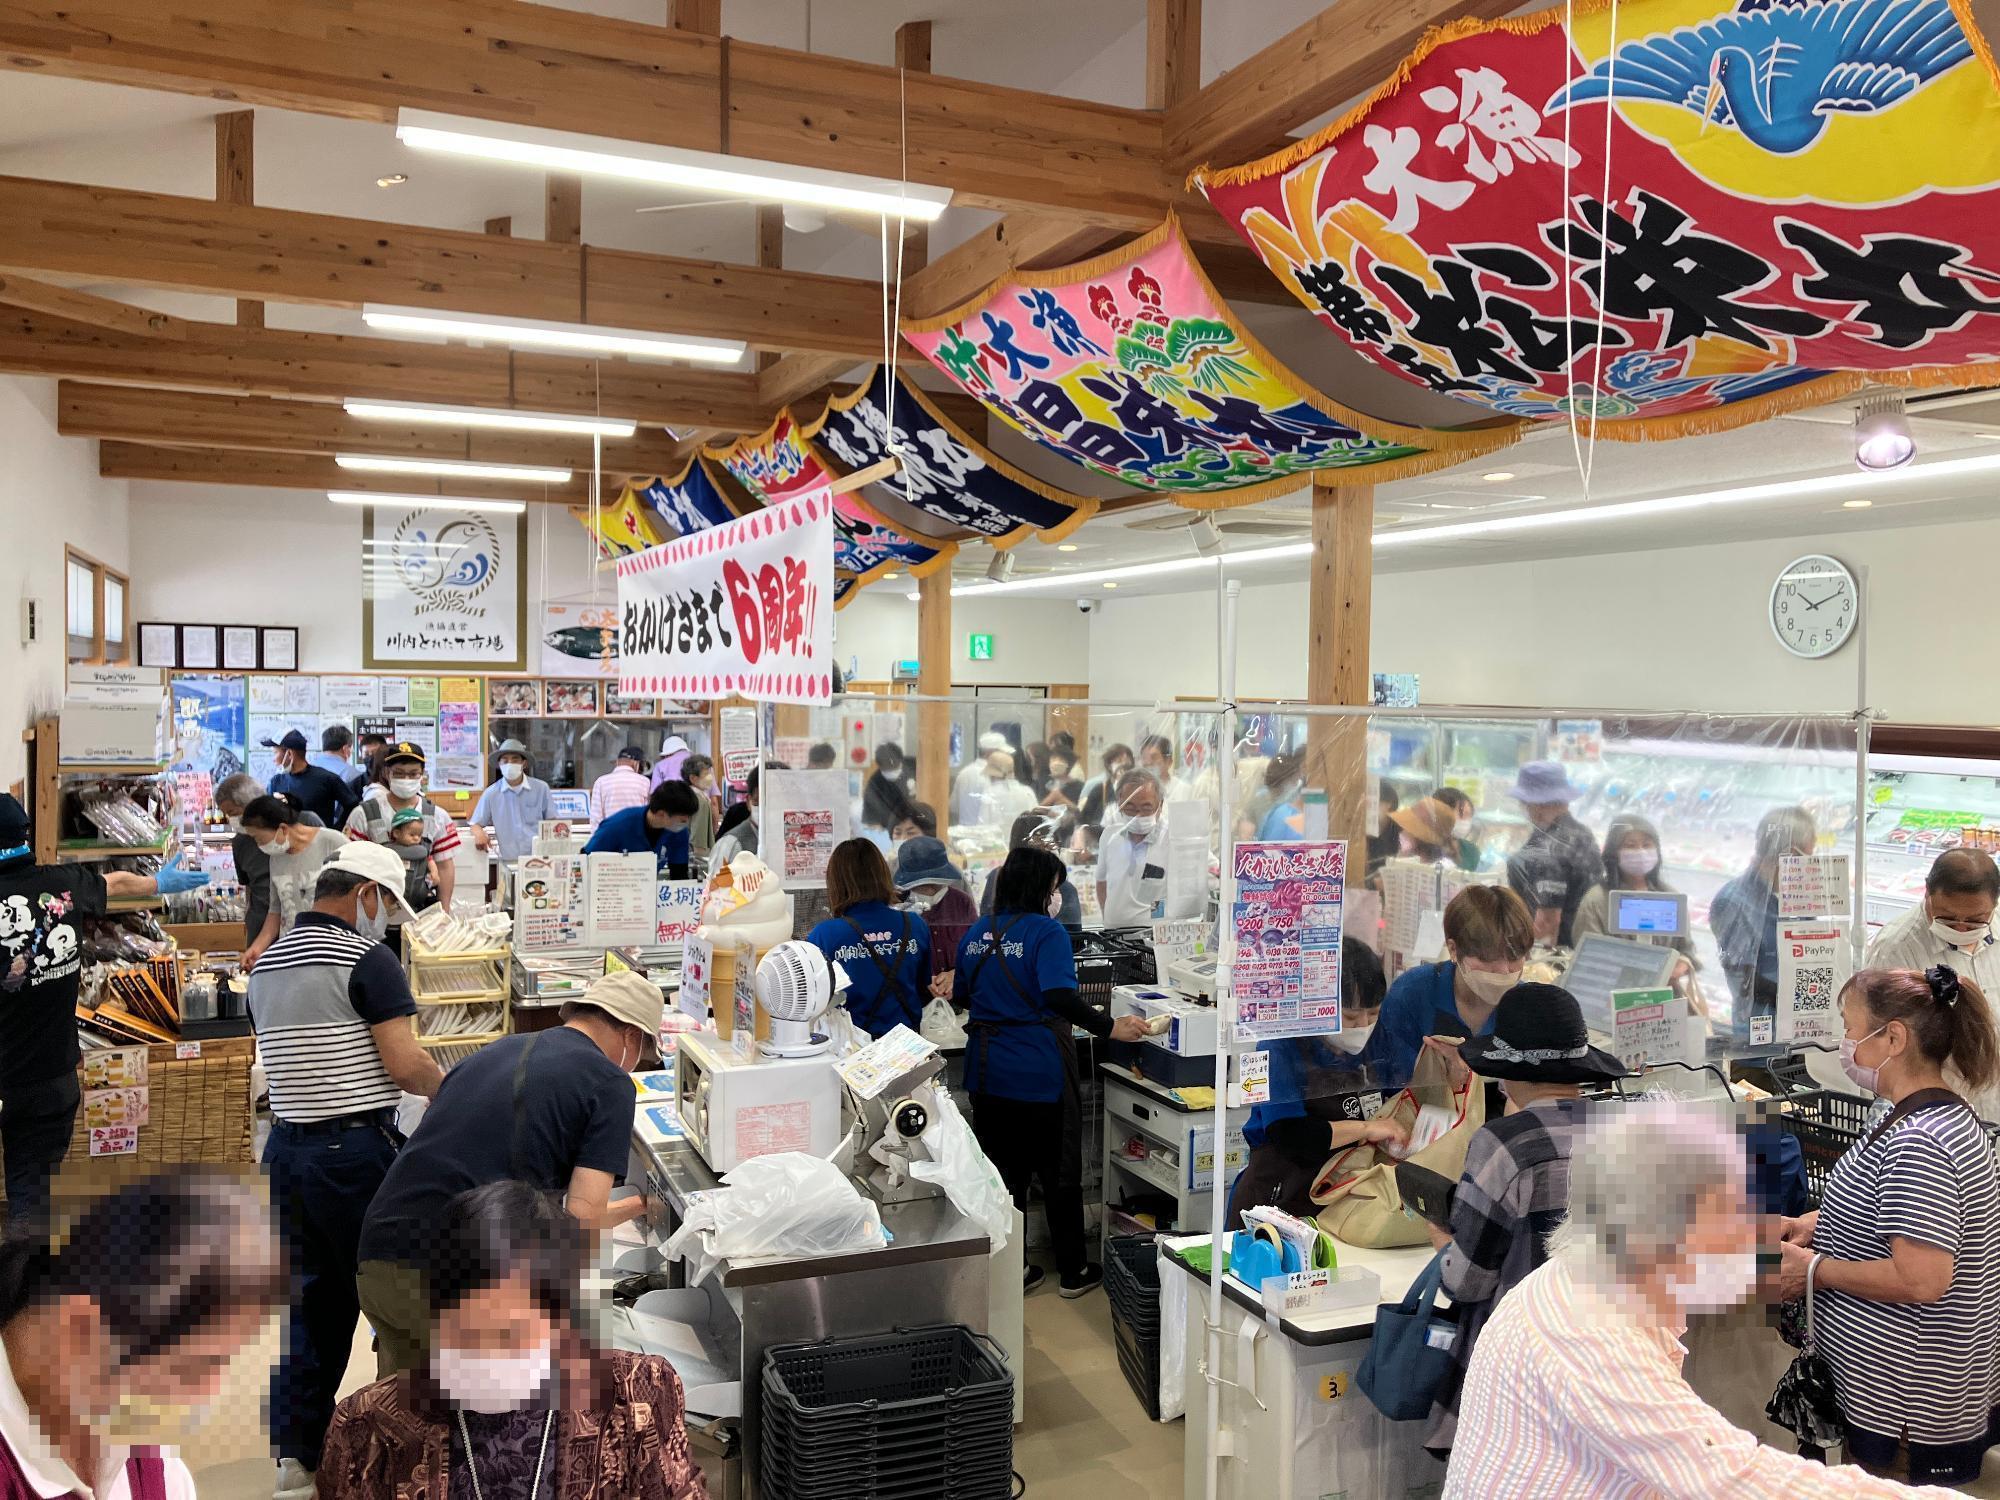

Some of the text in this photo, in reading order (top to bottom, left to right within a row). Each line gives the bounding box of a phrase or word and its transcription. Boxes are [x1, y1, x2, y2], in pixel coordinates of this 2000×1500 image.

[1362, 65, 1582, 233] 大漁
[979, 287, 1112, 382] 大漁
[1785, 583, 1797, 597] 10
[1837, 580, 1845, 595] 2
[1780, 601, 1789, 614] 9
[1842, 598, 1850, 612] 3
[1787, 617, 1795, 631] 8
[1835, 616, 1843, 629] 4
[1797, 629, 1805, 642] 7
[1809, 634, 1818, 648] 6
[1825, 628, 1833, 642] 5
[1243, 918, 1263, 930] 200
[1804, 945, 1835, 957] PayPay
[1317, 1006, 1335, 1017] 1000
